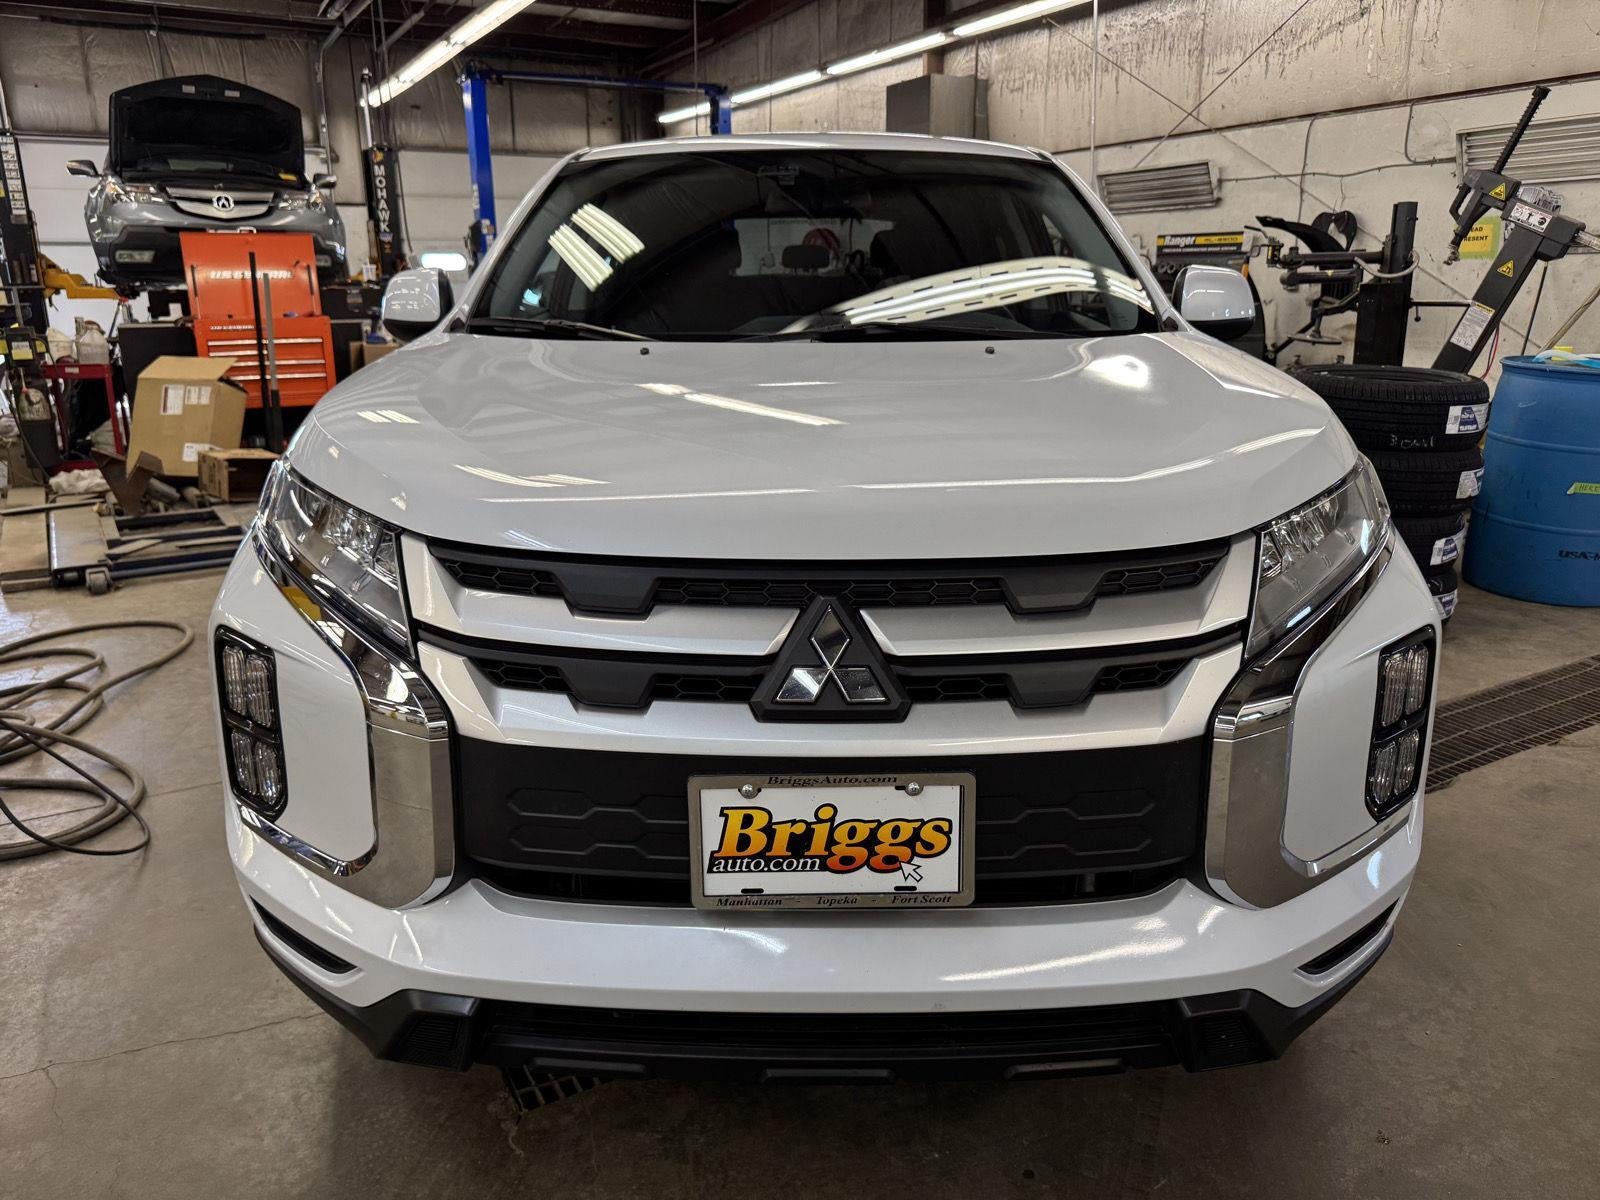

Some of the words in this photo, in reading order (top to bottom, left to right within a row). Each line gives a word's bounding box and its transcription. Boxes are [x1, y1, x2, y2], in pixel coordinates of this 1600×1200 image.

[374, 164, 391, 232] MOHAWK
[1163, 235, 1196, 248] Ranger
[767, 775, 898, 787] BriggsAuto.com
[710, 803, 953, 874] Briggs
[711, 857, 821, 872] auto.com
[716, 897, 783, 906] Manhattan
[816, 896, 858, 905] Topeka
[891, 895, 921, 905] Fort
[922, 894, 952, 904] Scott
